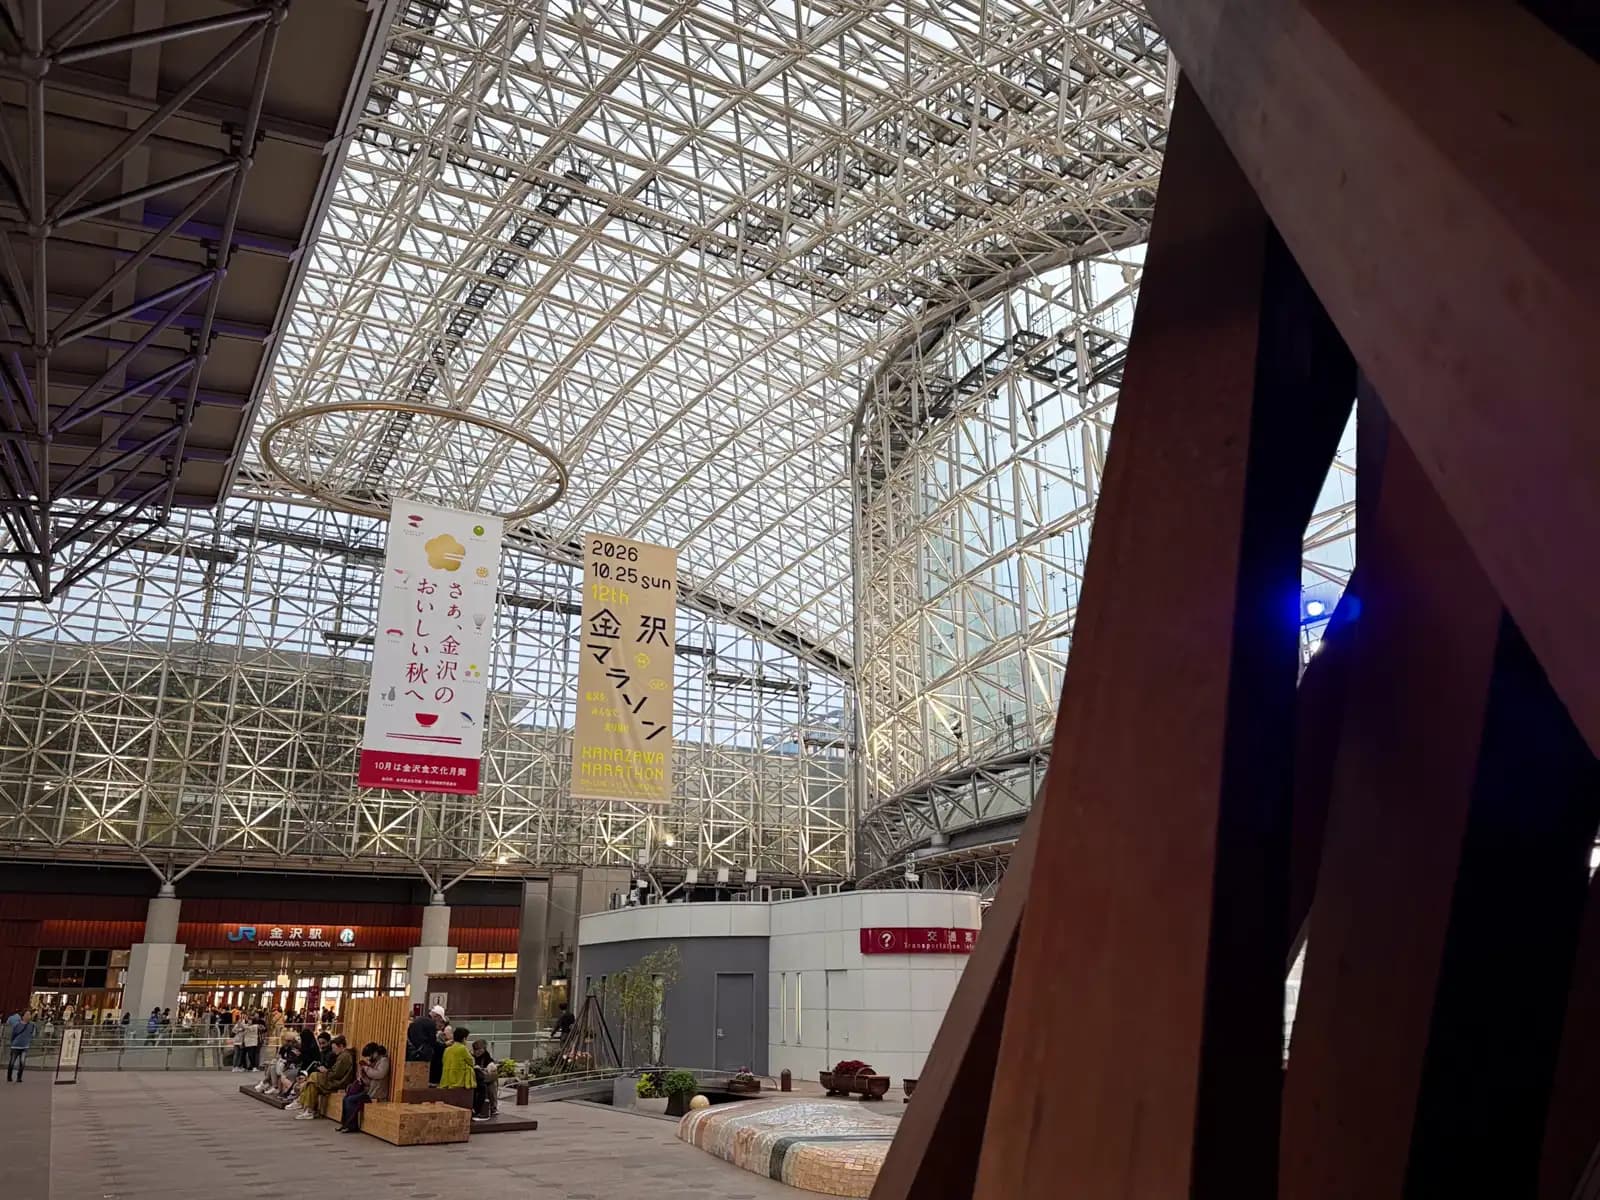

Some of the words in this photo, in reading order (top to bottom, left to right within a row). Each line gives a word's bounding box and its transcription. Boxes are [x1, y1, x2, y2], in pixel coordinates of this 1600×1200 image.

[592, 540, 638, 562] 2026
[592, 562, 638, 583] 10.25
[641, 575, 671, 590] sun
[592, 583, 629, 606] 12th
[589, 608, 669, 647] 金沢
[404, 578, 438, 701] おいしい秋へ
[587, 644, 667, 740] マラソン
[582, 746, 665, 765] KANAZAWA
[581, 761, 664, 783] MARATHON
[228, 926, 256, 941] JR
[258, 940, 300, 948] KANAZAWA
[269, 927, 322, 940] 金沢駅
